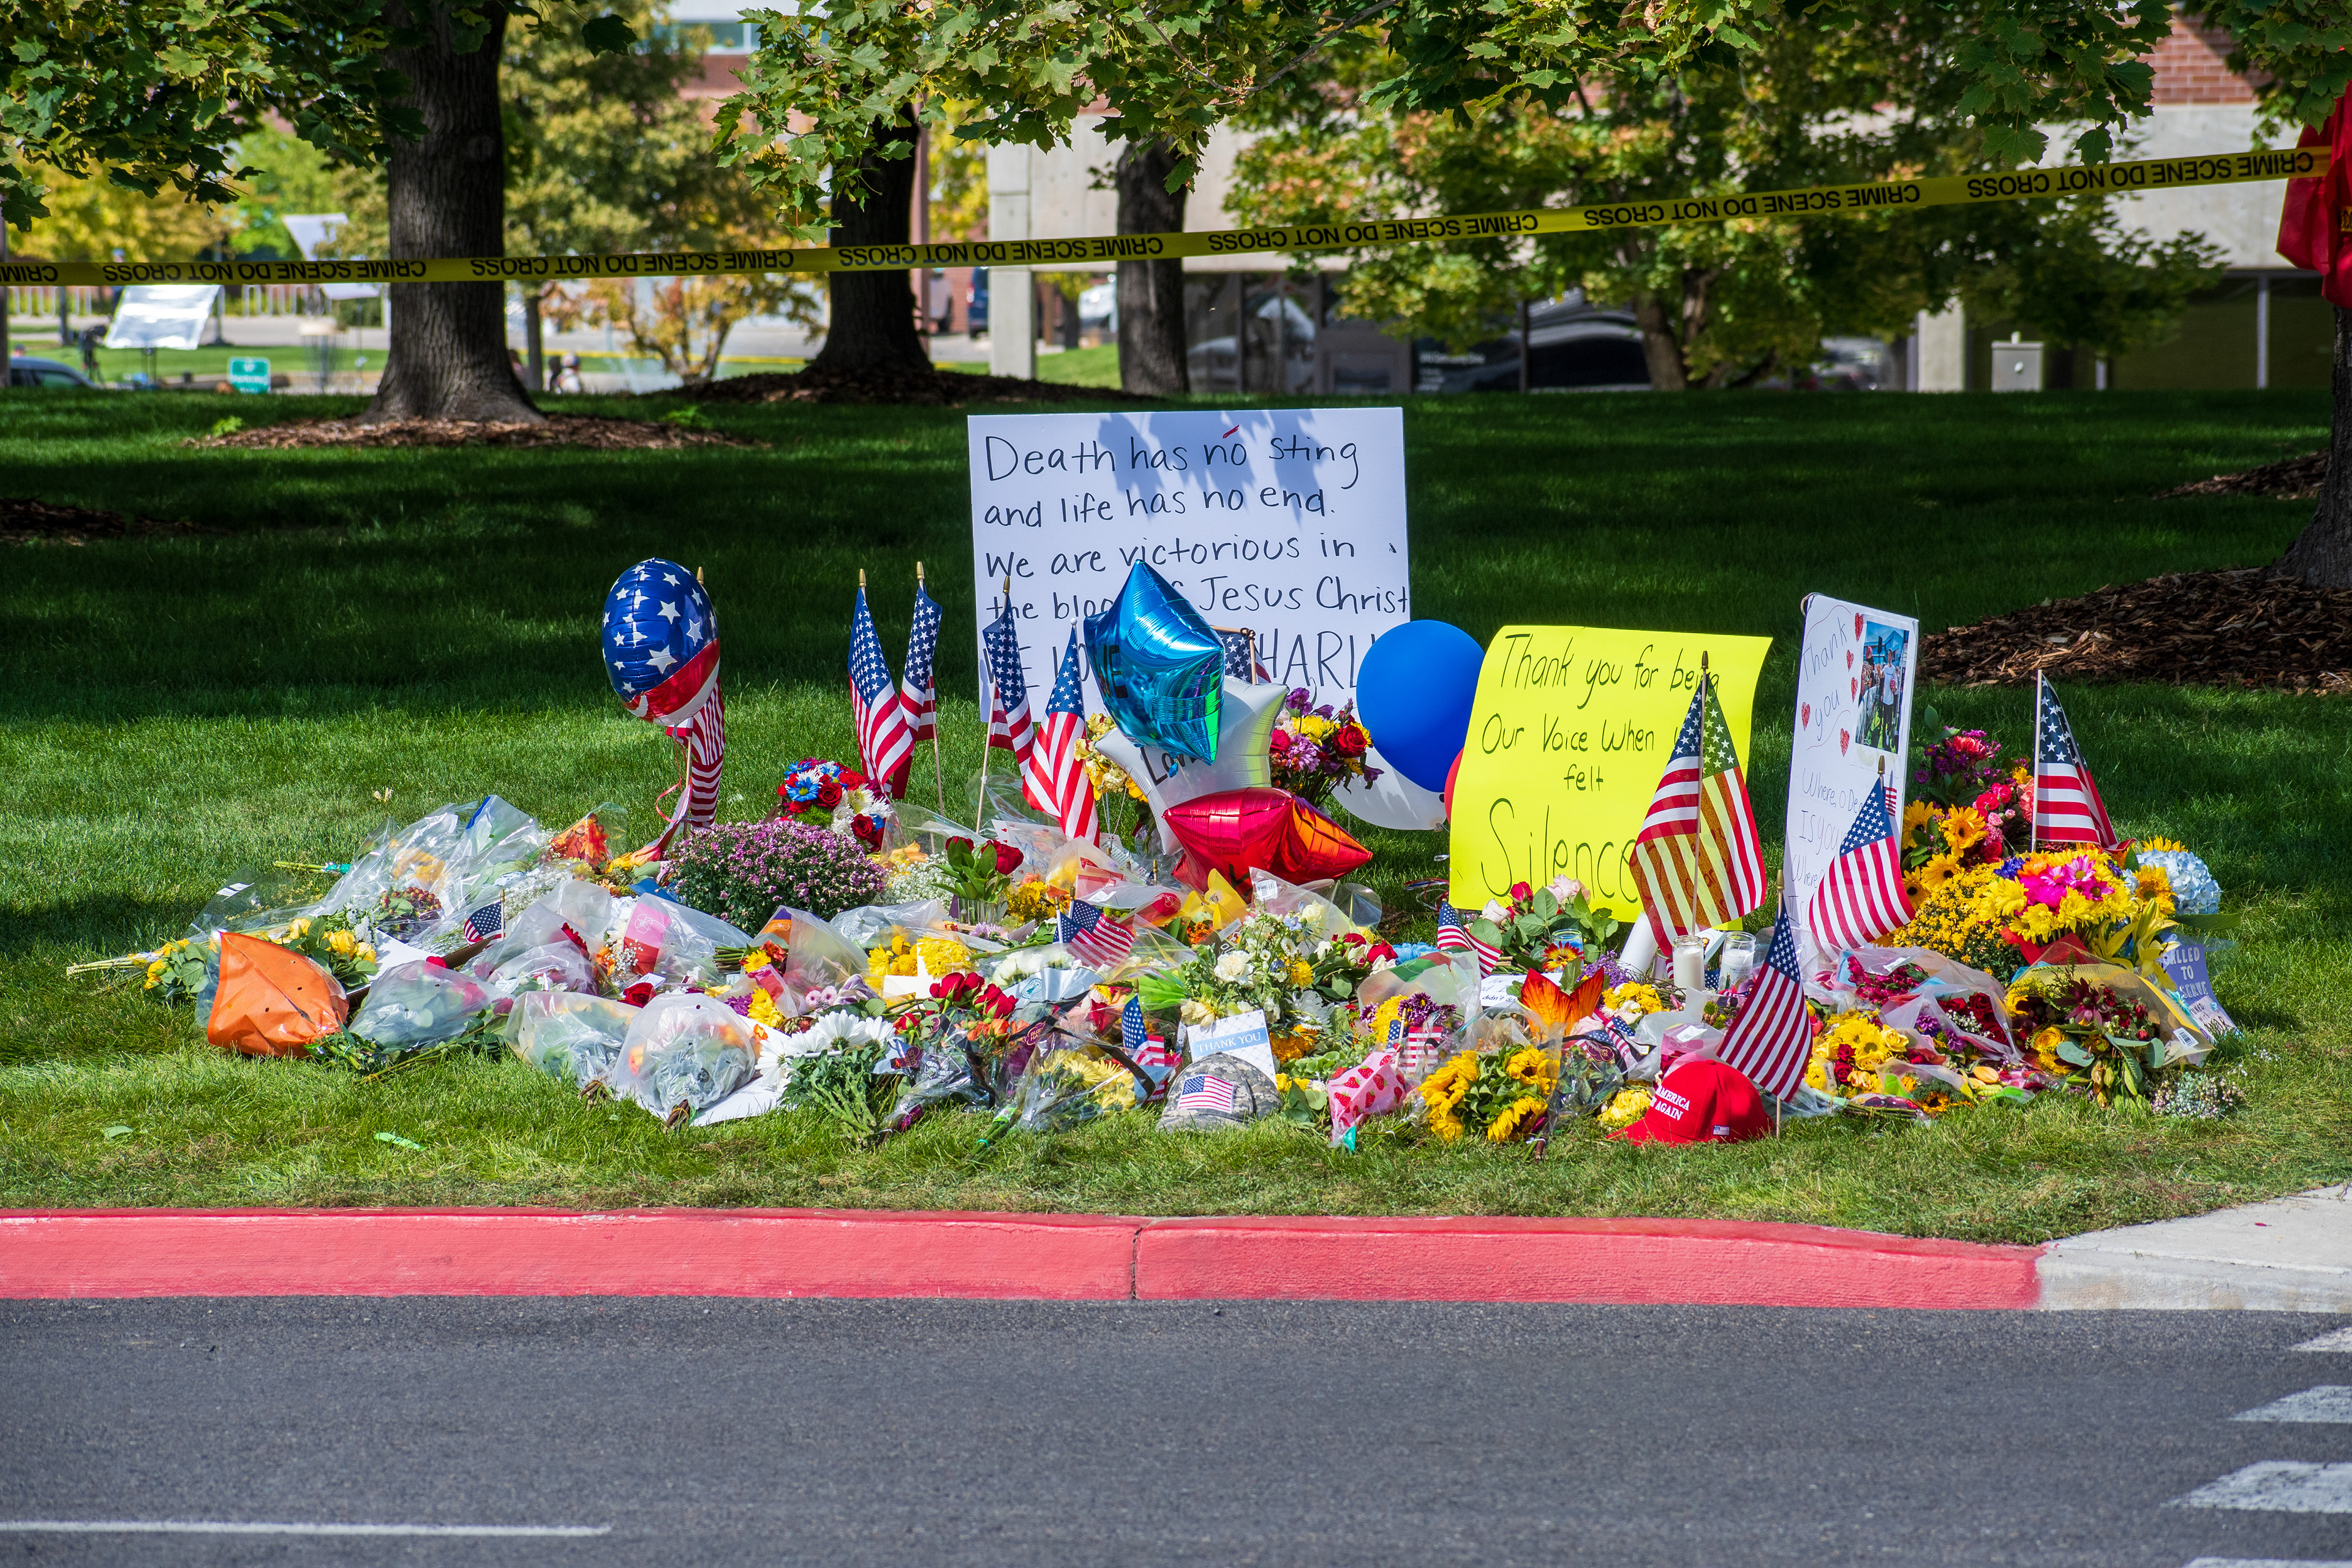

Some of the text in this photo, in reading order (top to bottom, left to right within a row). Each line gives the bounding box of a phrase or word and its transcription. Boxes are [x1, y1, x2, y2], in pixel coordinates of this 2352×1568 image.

[1967, 151, 2314, 198] CRIME SCENE DO NOT CROSS
[1583, 184, 1921, 227] CRIME SCENE DO NOT CROSS
[1208, 214, 1539, 251] CRIME SCENE DO NOT CROSS
[470, 250, 794, 276] CRIME SCENE DO NOT CROSS
[839, 237, 1164, 266] CRIME SCENE DO NOT CROSS
[0, 265, 59, 282] CRIM
[102, 261, 427, 282] CRIME SCENE DO NOT CROSS
[984, 432, 1359, 490] Death has no sting
[984, 486, 1335, 529] and life has no end.
[986, 532, 1355, 579] We are victorious in
[1053, 592, 1112, 619] bloo
[1199, 575, 1303, 612] Jesus
[1316, 576, 1408, 615] Christ
[1802, 617, 1849, 682] Thank
[1501, 633, 1575, 691] Thank
[1577, 657, 1624, 710] you
[1634, 644, 1661, 690] for
[1815, 689, 1841, 742] you
[1482, 713, 1525, 755] Our
[1542, 714, 1589, 752] Voice
[1601, 718, 1655, 752] When
[1563, 763, 1604, 792] felt
[1839, 791, 1847, 809] O
[1799, 810, 1817, 843] Is
[1480, 797, 1639, 903] Silence
[1791, 854, 1819, 889] Where
[2179, 981, 2209, 999] SERVE
[2180, 965, 2194, 981] TO
[1196, 1031, 1262, 1053] THANK YOU
[1655, 1101, 1684, 1121] AGAIN
